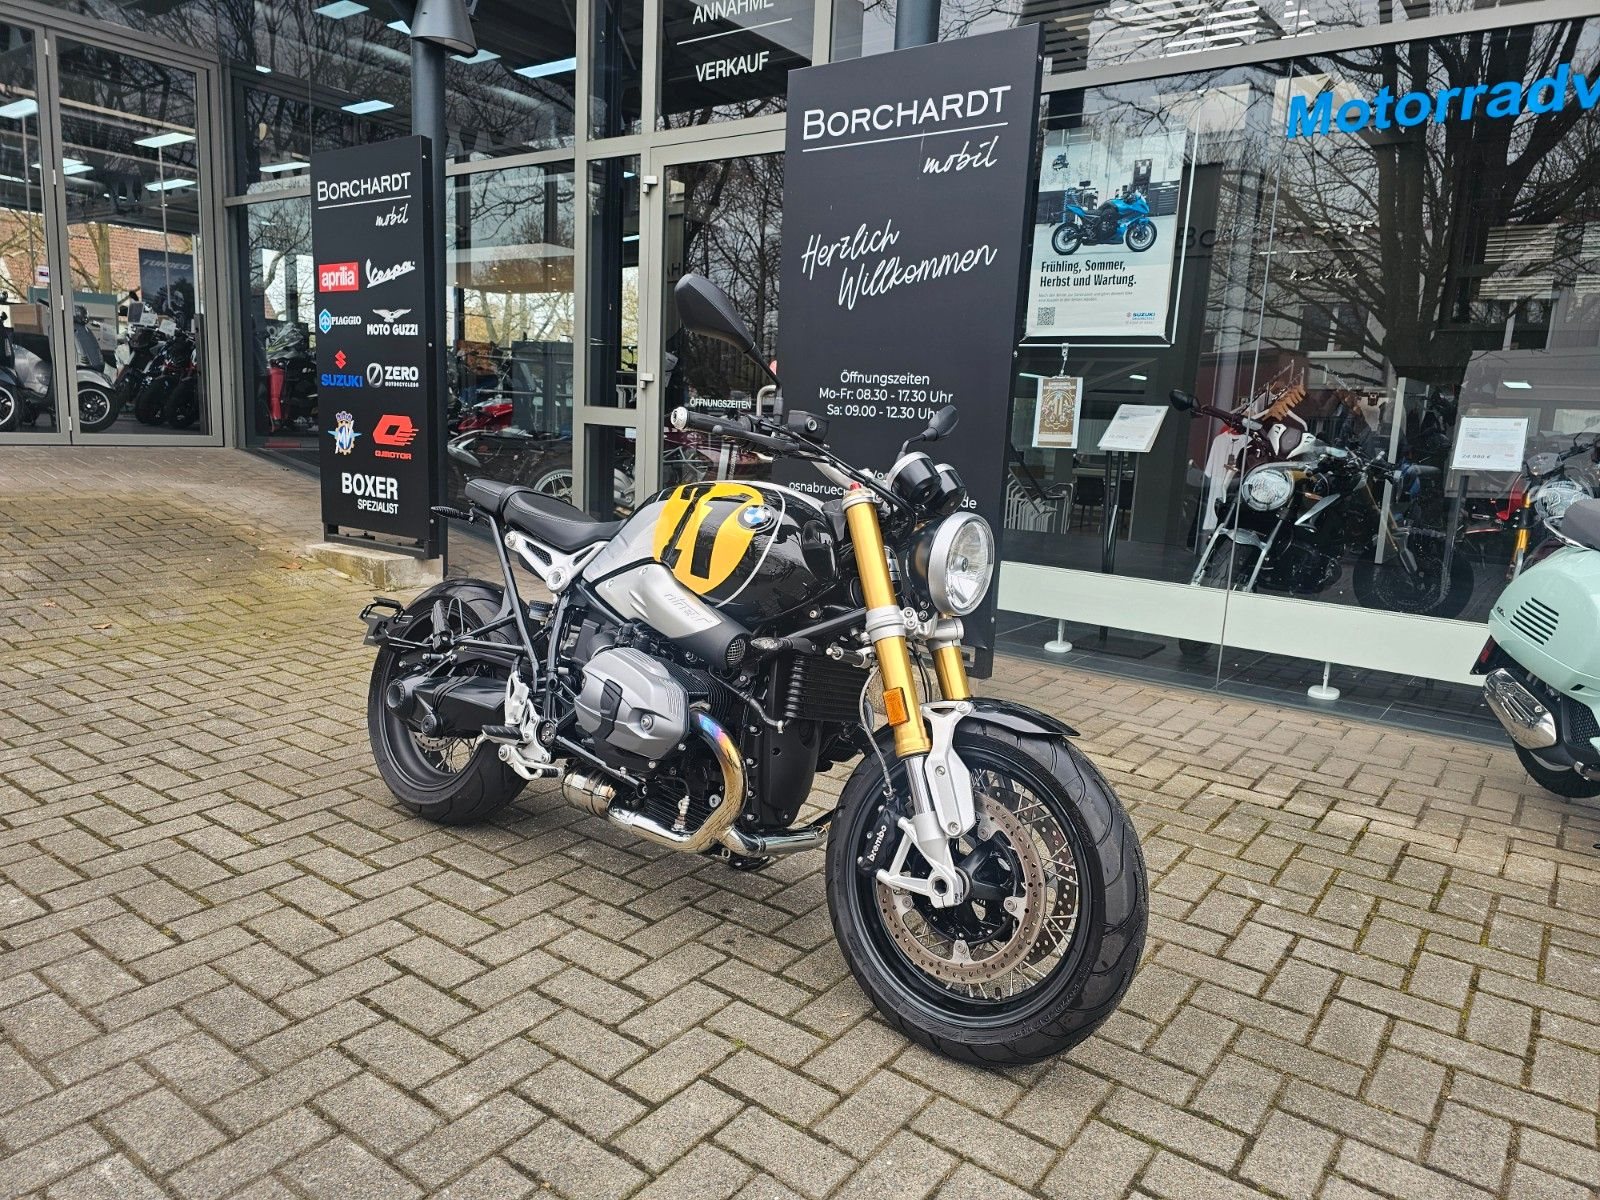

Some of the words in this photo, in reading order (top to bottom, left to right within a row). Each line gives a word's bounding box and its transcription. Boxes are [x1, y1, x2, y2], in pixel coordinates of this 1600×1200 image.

[695, 50, 770, 82] VERKAUF
[802, 85, 1012, 141] BORCHARDT
[1286, 62, 1600, 140] Motorradv
[922, 135, 1000, 174] mobil
[317, 171, 411, 202] BORCHARDT
[375, 203, 409, 227] mobil
[801, 218, 901, 281] Herzlich
[321, 265, 355, 291] aprilia
[365, 258, 416, 289] Vespa
[838, 243, 998, 311] Willkommen
[1041, 261, 1082, 275] Frühling,
[1084, 259, 1126, 272] Sommer,
[1039, 276, 1071, 288] Herbst
[1073, 274, 1091, 287] und
[1094, 273, 1137, 288] Wartung.
[331, 315, 362, 326] PIAGGIO
[366, 323, 391, 336] MOTO
[392, 323, 419, 336] GUZZI
[321, 373, 364, 388] SUZUKI
[384, 365, 419, 381] ZERO
[840, 369, 930, 387] Öffnungszeiten
[689, 396, 752, 409] ÖFFNUNGSZEITEN
[819, 387, 854, 400] Mo-Fr:
[856, 388, 888, 401] 08.30
[898, 389, 927, 402] 17.30
[929, 390, 954, 403] Uhr
[827, 404, 843, 415] Sa:
[844, 404, 877, 417] 09.00
[886, 406, 915, 418] 12.30
[917, 407, 939, 420] Uh
[341, 472, 399, 500] BOXER
[357, 498, 399, 514] SPEZIALIST
[866, 824, 887, 862] brembo
